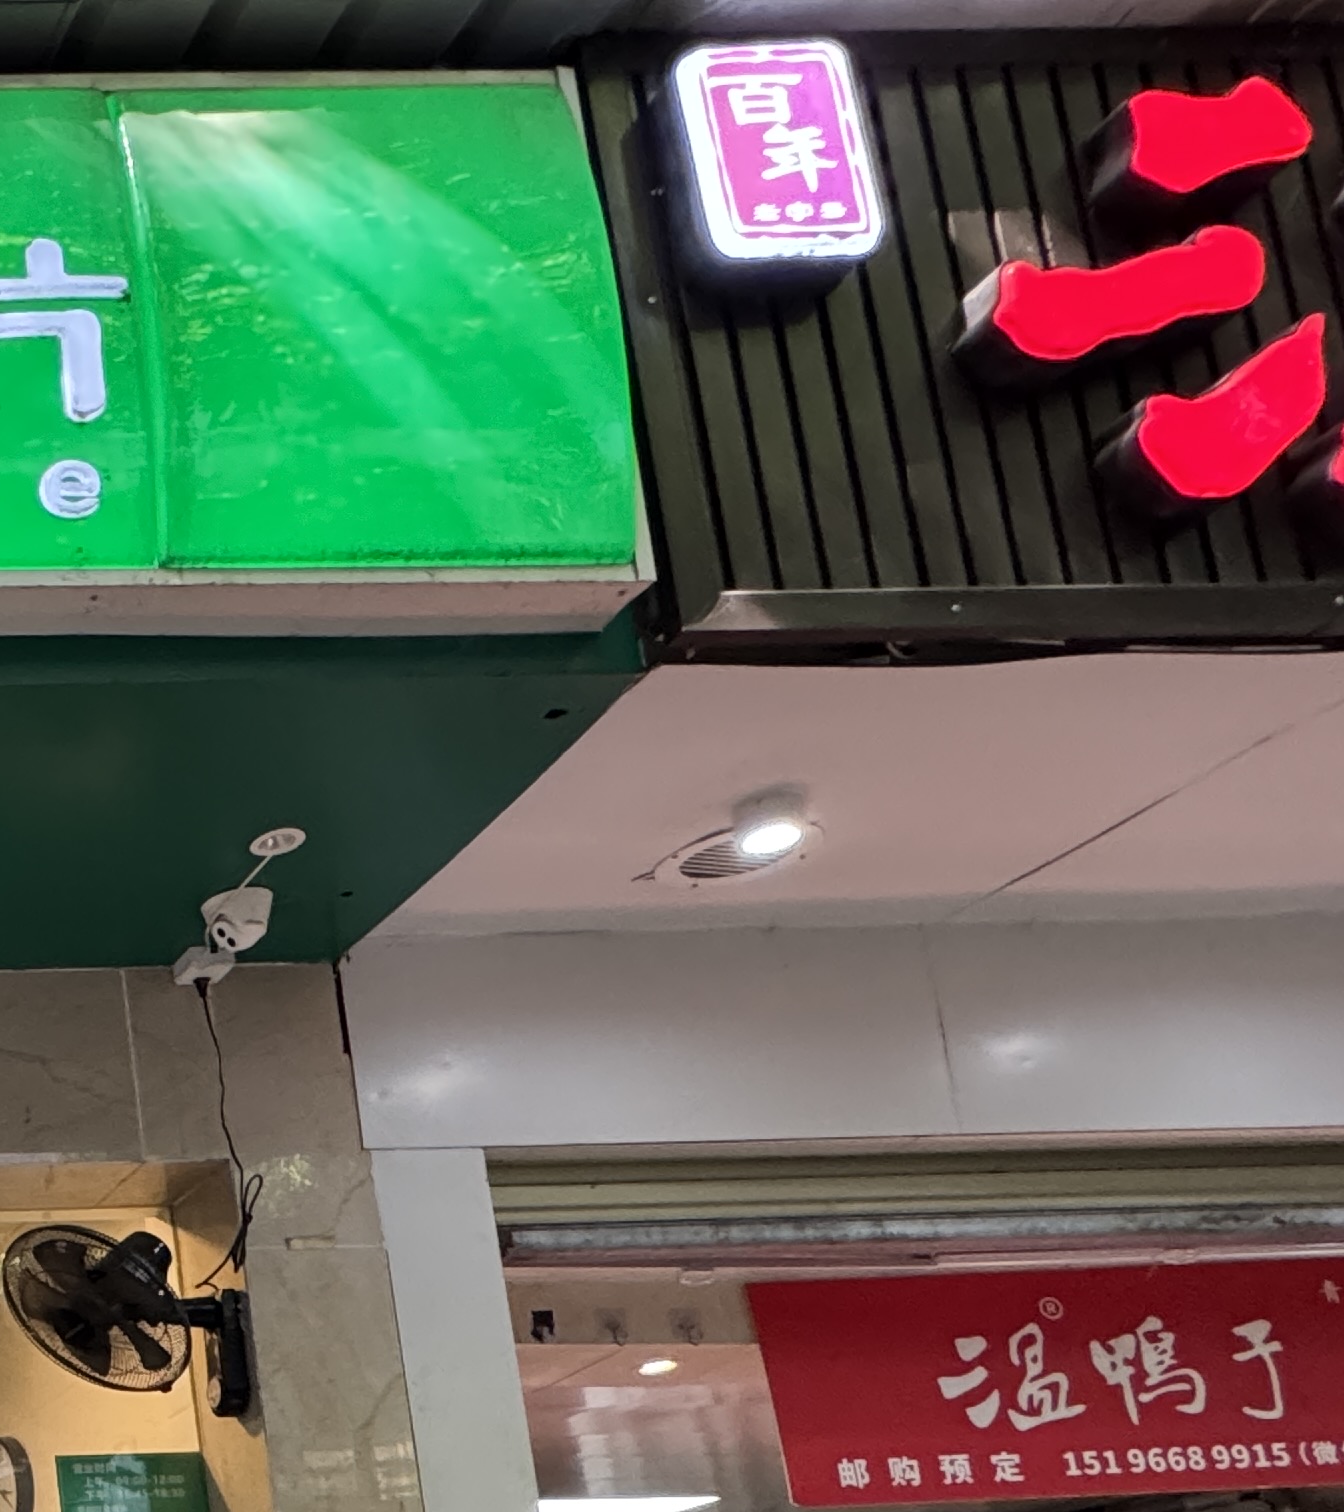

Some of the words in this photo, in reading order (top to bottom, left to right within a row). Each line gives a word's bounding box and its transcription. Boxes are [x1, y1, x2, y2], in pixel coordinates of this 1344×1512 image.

[706, 73, 840, 193] 百年
[838, 1454, 1025, 1488] 邮购预定
[1299, 1440, 1344, 1466] （微
